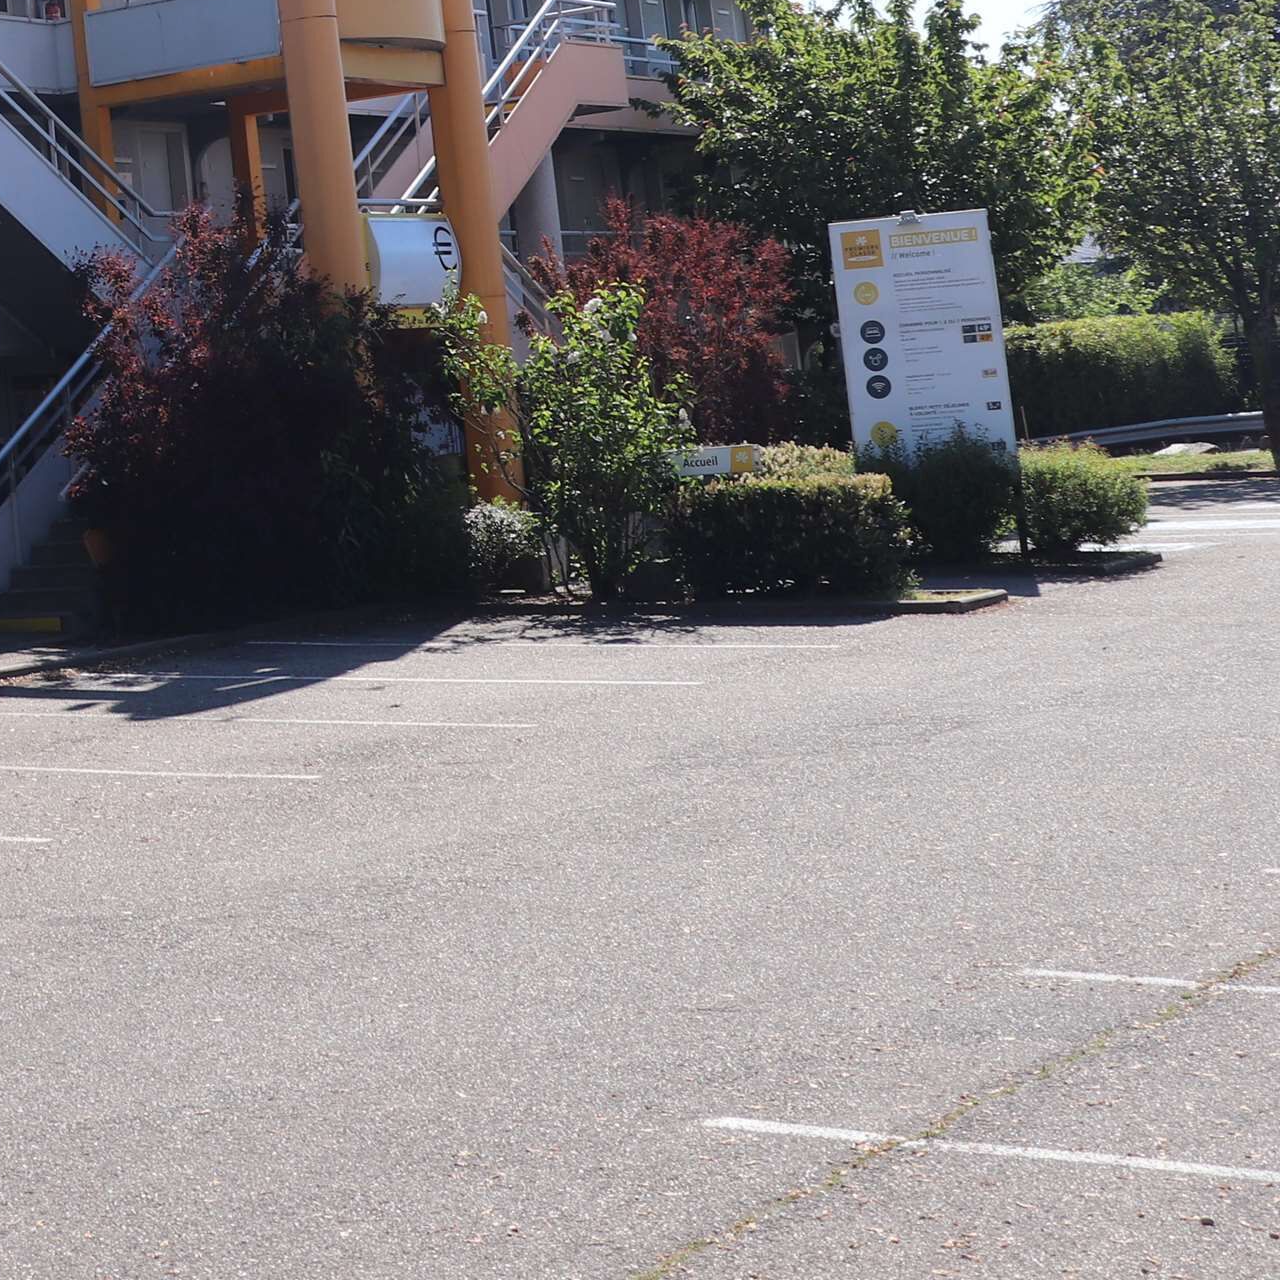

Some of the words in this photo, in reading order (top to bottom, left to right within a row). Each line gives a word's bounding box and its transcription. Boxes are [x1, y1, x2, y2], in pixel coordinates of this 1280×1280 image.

[890, 229, 969, 247] BIENVENUE
[898, 250, 931, 259] Welcome
[683, 456, 718, 468] Accueil
